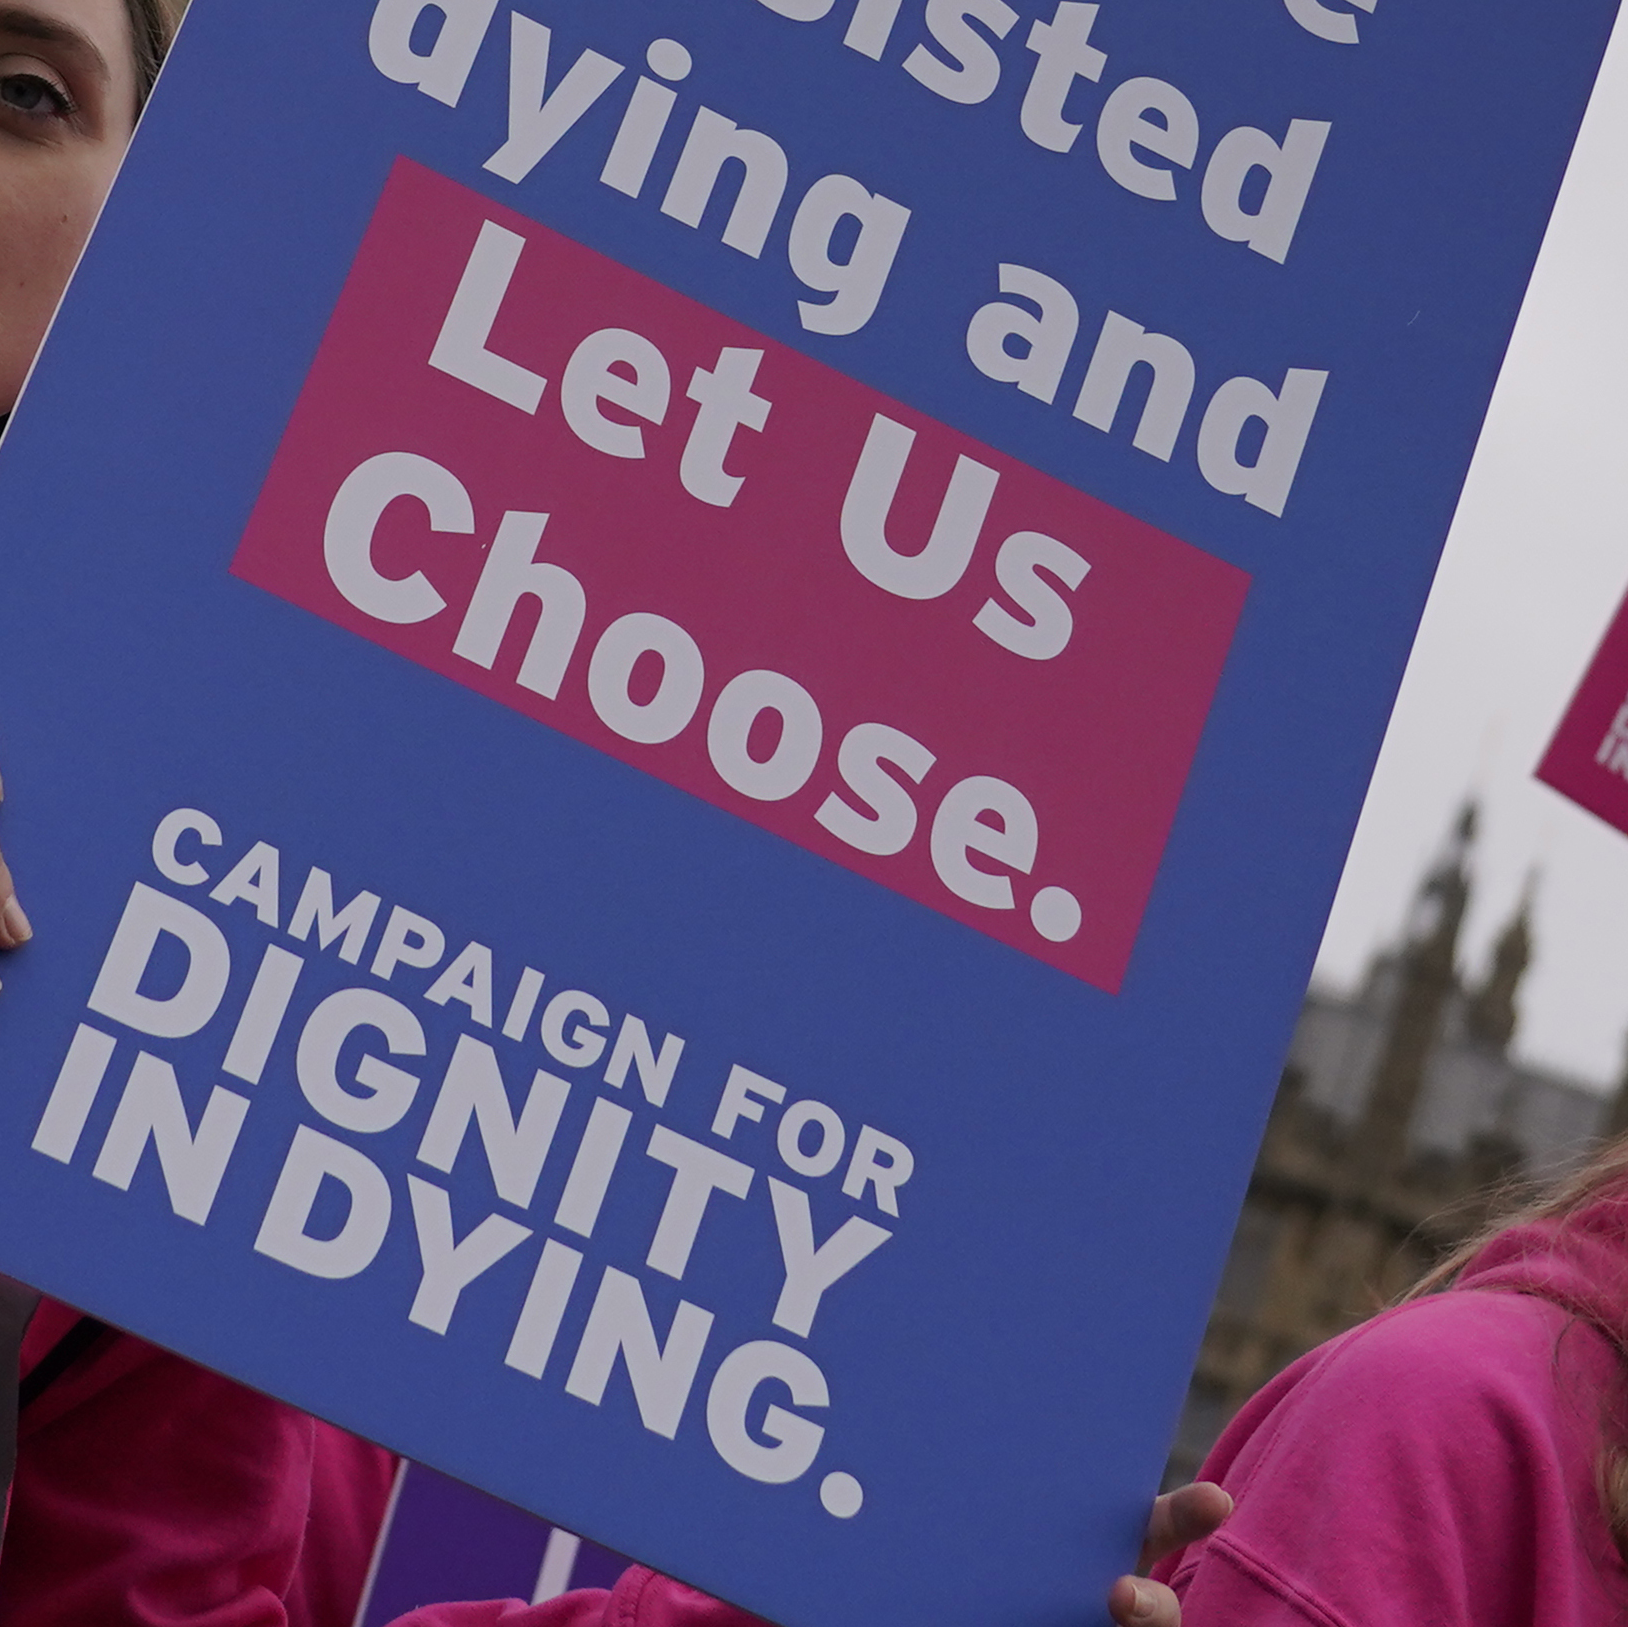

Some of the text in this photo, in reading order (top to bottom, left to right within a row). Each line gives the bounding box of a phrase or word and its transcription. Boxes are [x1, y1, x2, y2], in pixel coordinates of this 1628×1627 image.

[428, 219, 1092, 661] Let Us
[966, 263, 1330, 518] and
[323, 451, 1082, 943] Choose.
[86, 881, 893, 1339] DIGNITY
[152, 808, 914, 1218] CAMPAIGN FOR
[31, 1022, 251, 1226] IN
[253, 1123, 864, 1519] DYING.
